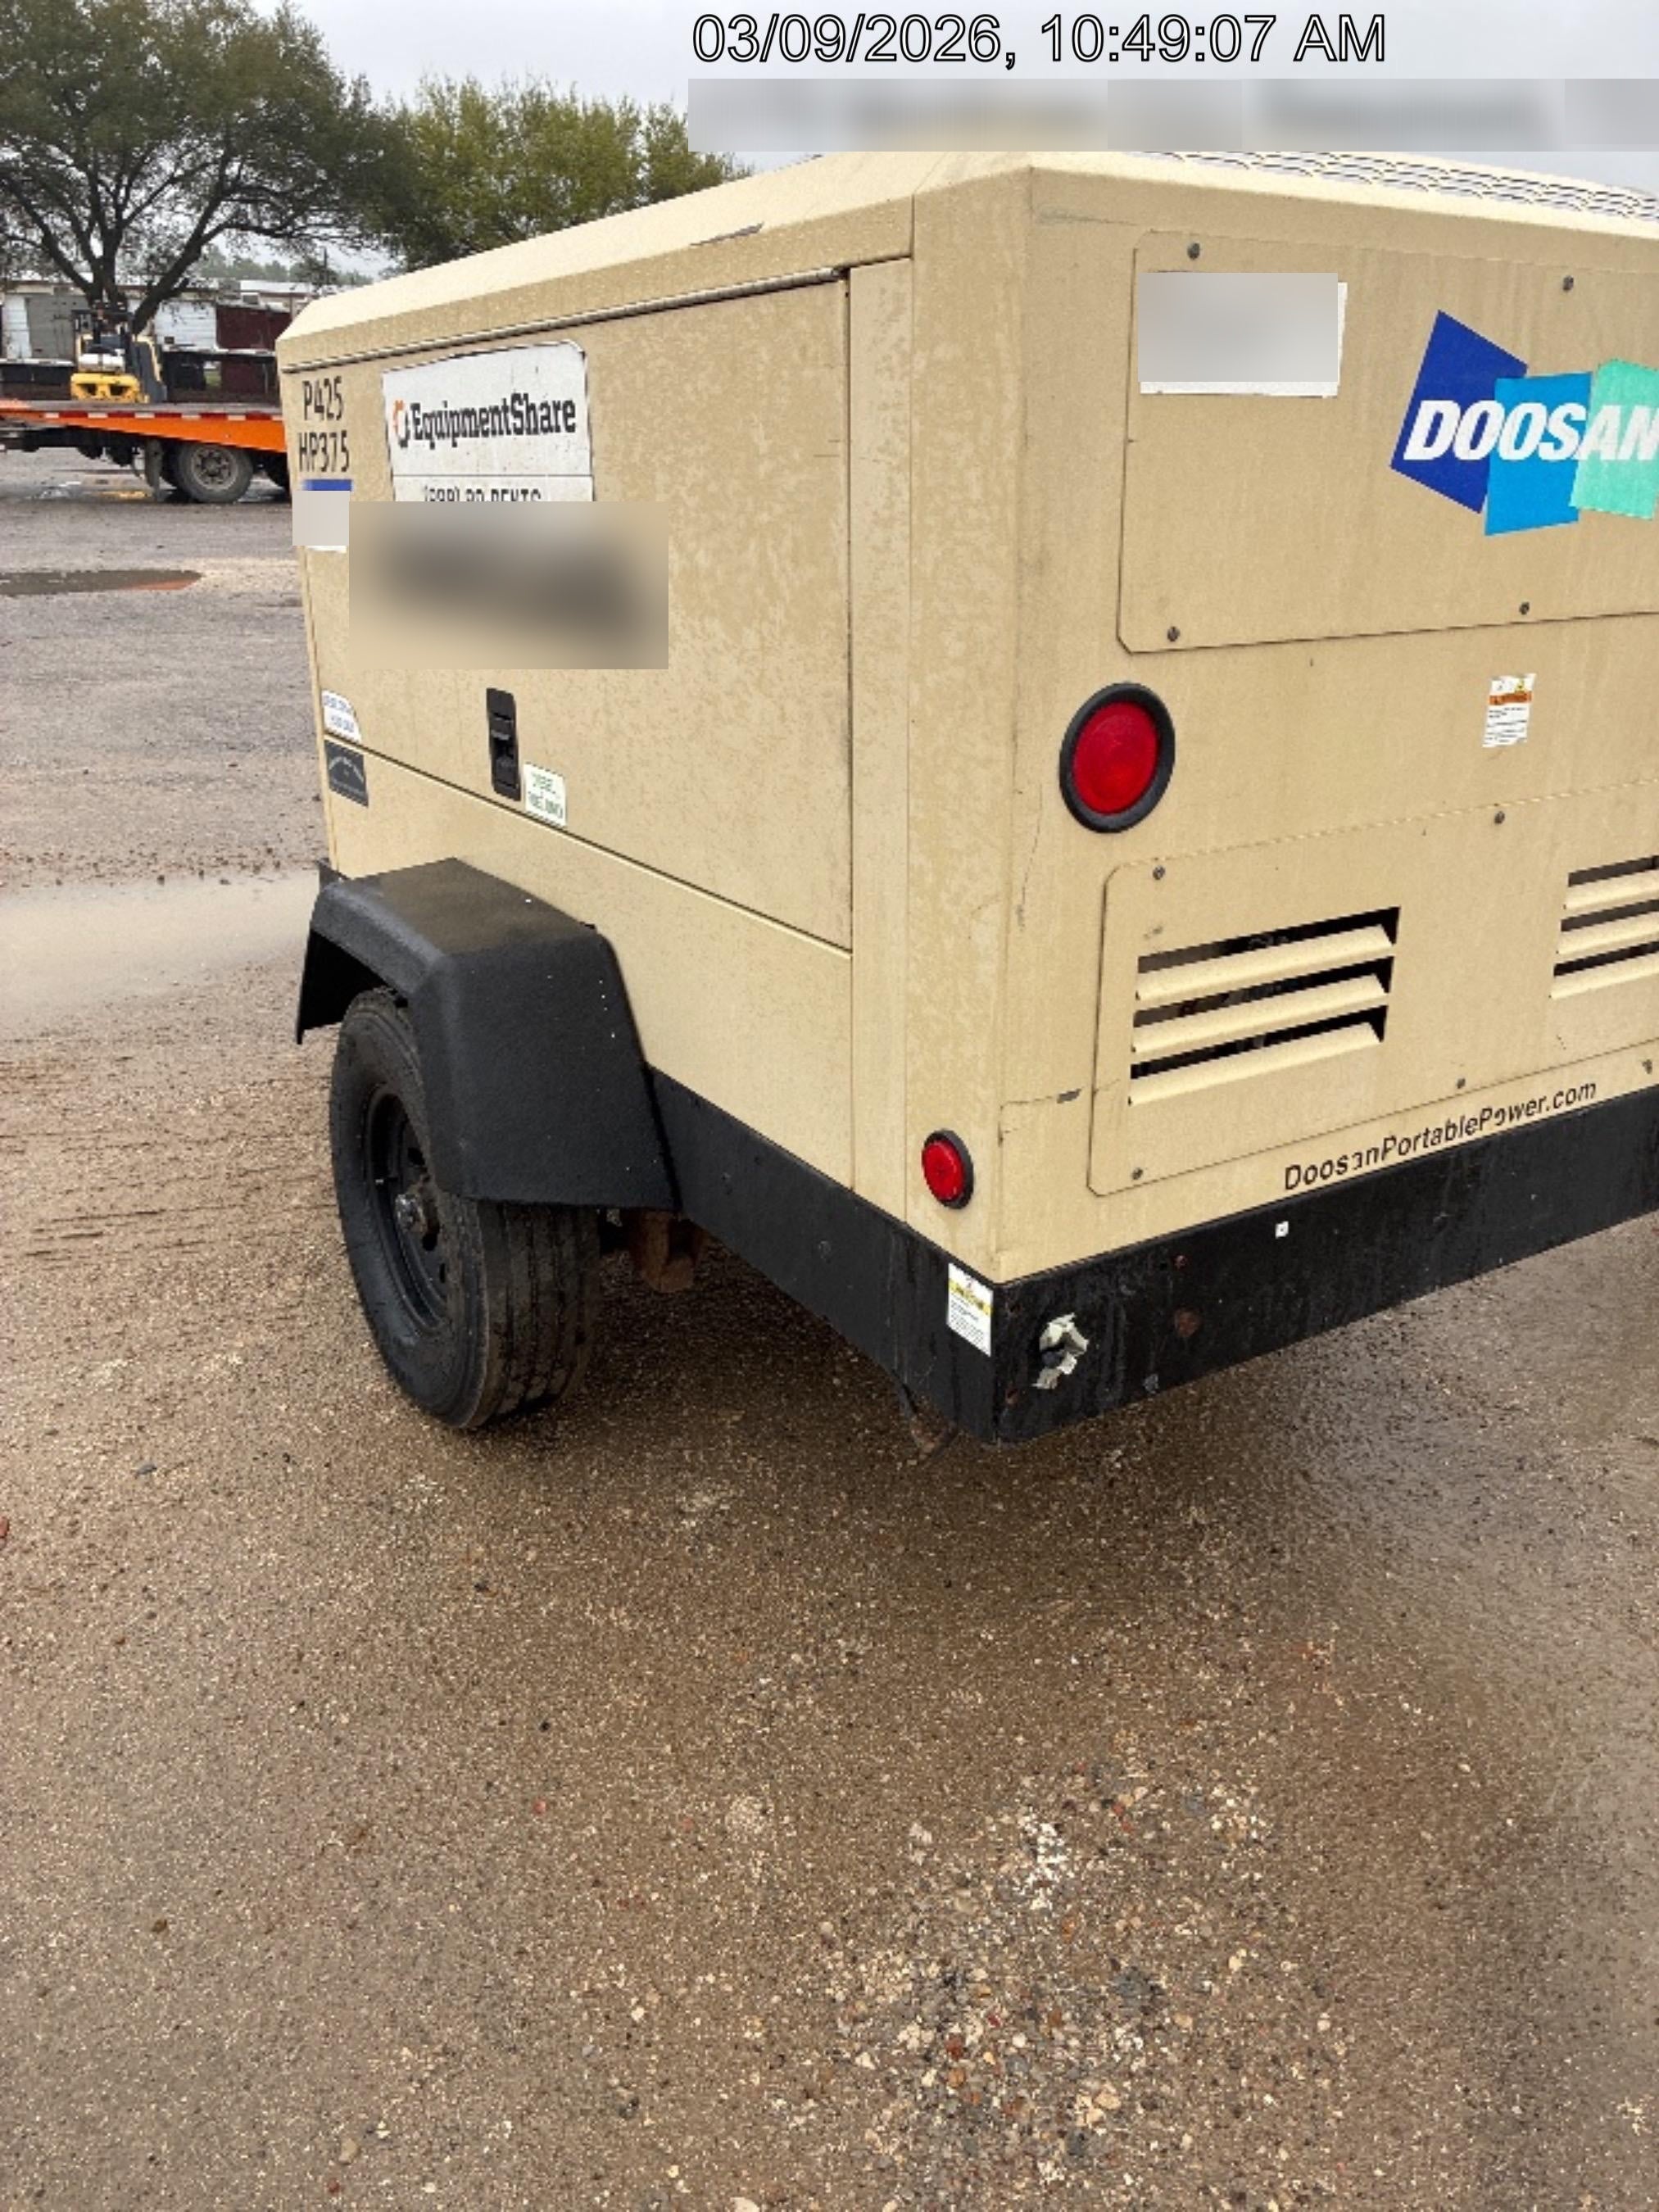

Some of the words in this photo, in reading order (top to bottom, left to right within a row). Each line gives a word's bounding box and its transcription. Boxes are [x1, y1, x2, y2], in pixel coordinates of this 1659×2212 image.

[301, 375, 344, 421] P425
[409, 392, 577, 450] EquipmentShare
[297, 429, 351, 473] HP375
[1402, 399, 1659, 461] DOOSAN
[1284, 1081, 1597, 1191] DoosanPortablePower.com
